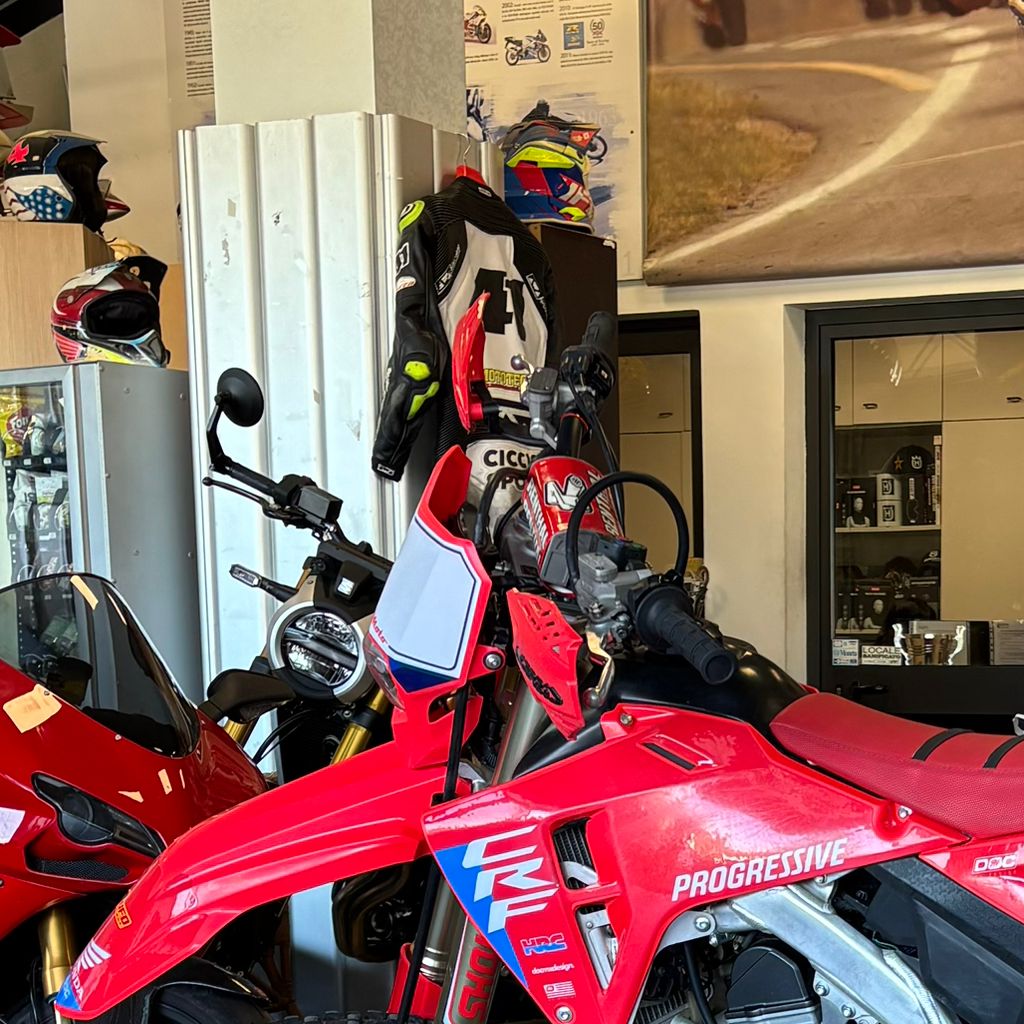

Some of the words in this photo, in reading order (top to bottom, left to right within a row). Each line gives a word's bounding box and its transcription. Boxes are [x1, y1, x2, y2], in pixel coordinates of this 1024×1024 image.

[485, 369, 526, 387] OTOTEC
[484, 450, 536, 468] CICC
[462, 824, 559, 933] CRF
[671, 838, 848, 902] PROGRESSIVE
[520, 933, 567, 956] HRC
[458, 934, 497, 1021] SHO
